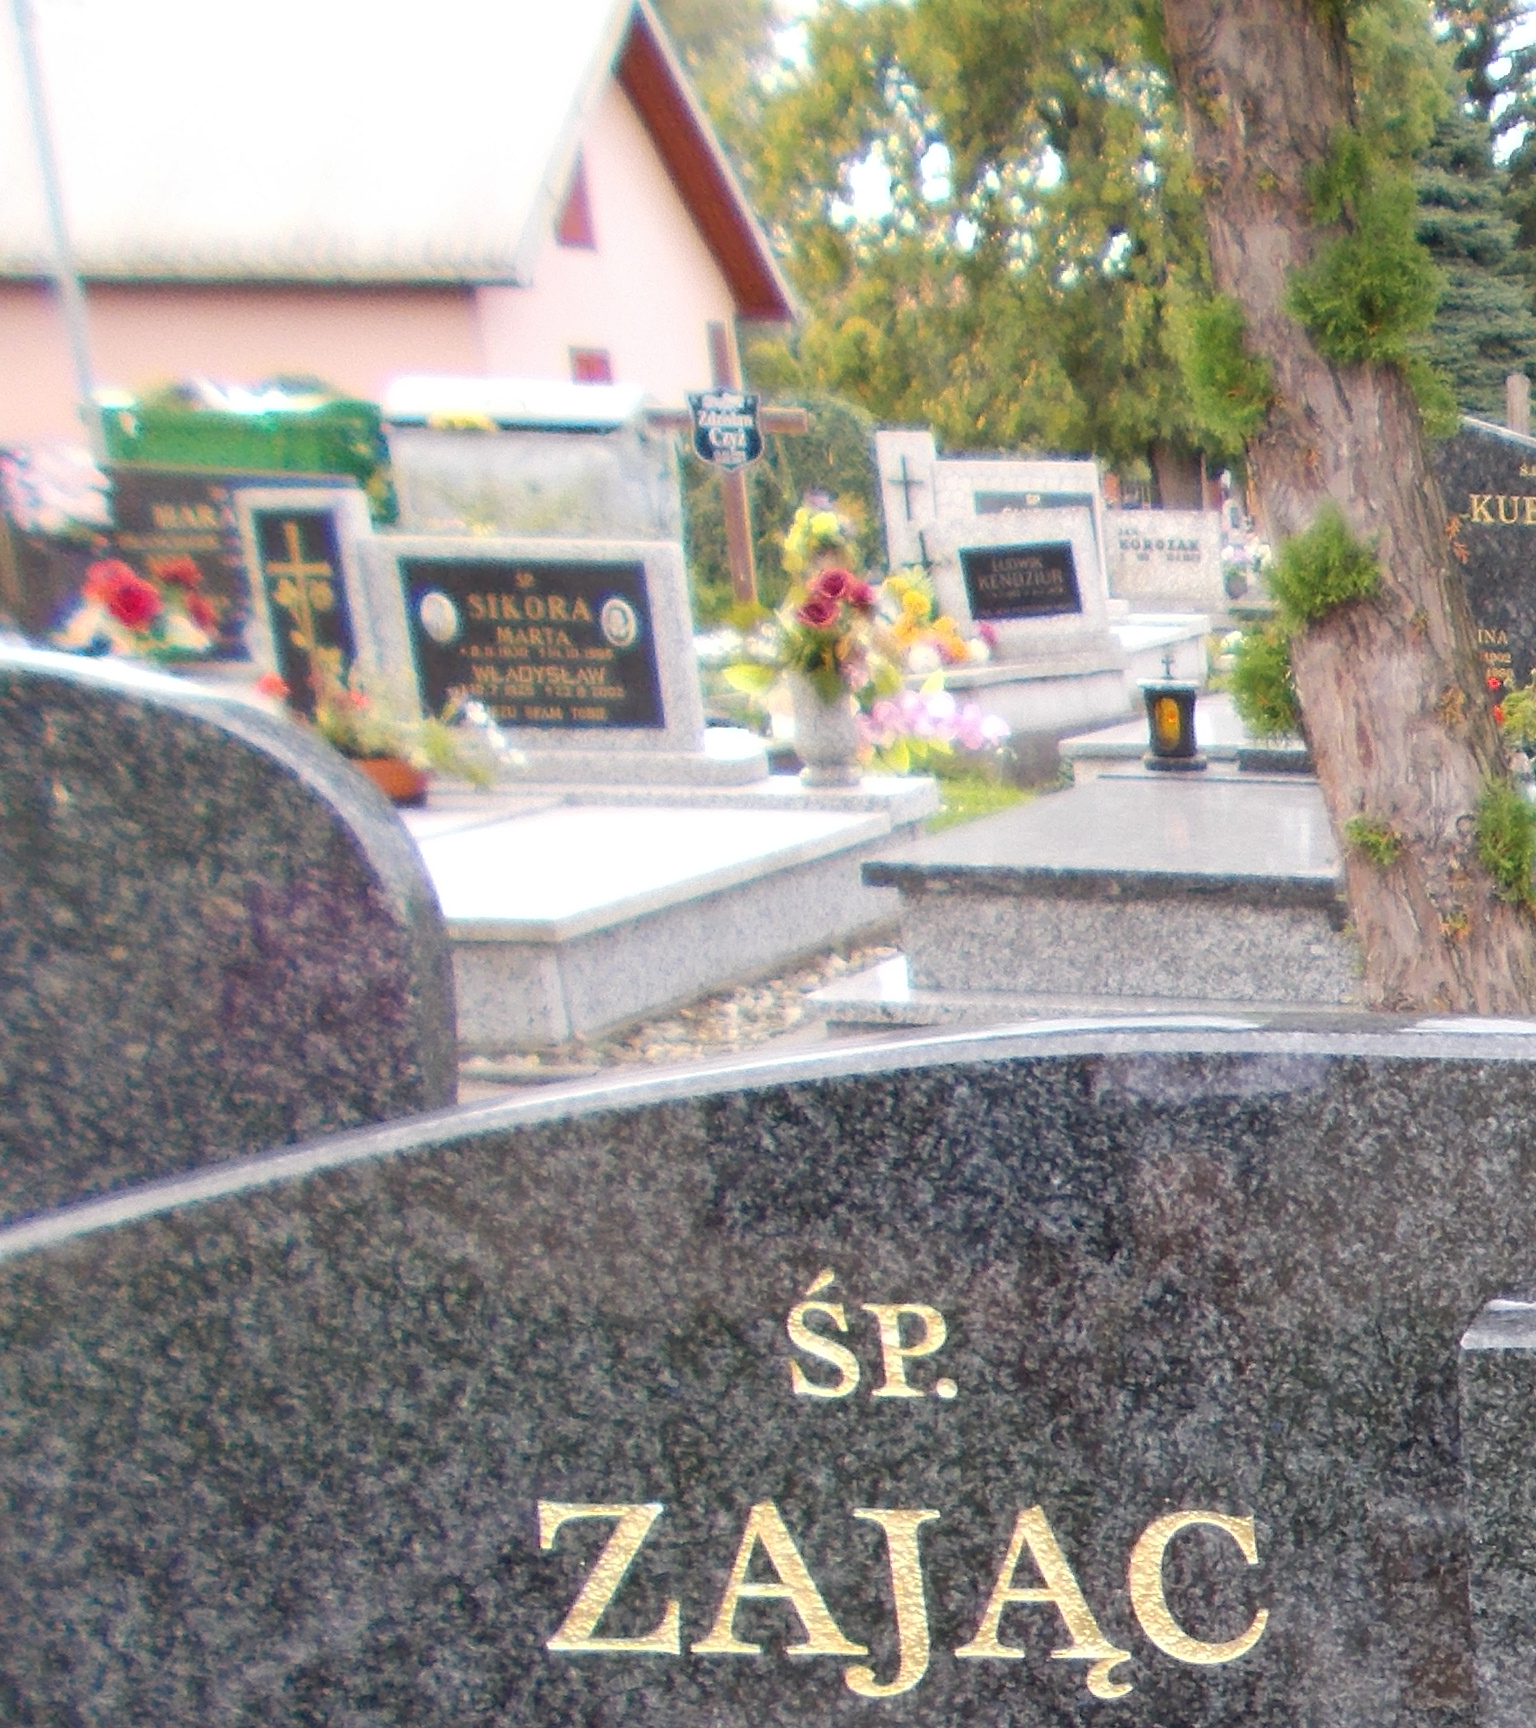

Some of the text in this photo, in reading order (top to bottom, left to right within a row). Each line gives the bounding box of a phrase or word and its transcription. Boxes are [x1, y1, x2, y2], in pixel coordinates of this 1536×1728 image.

[466, 592, 593, 622] SIKORA
[496, 626, 573, 646] MARTA
[786, 1269, 959, 1399] ŚP.
[537, 1500, 1269, 1699] ZAJĄC
